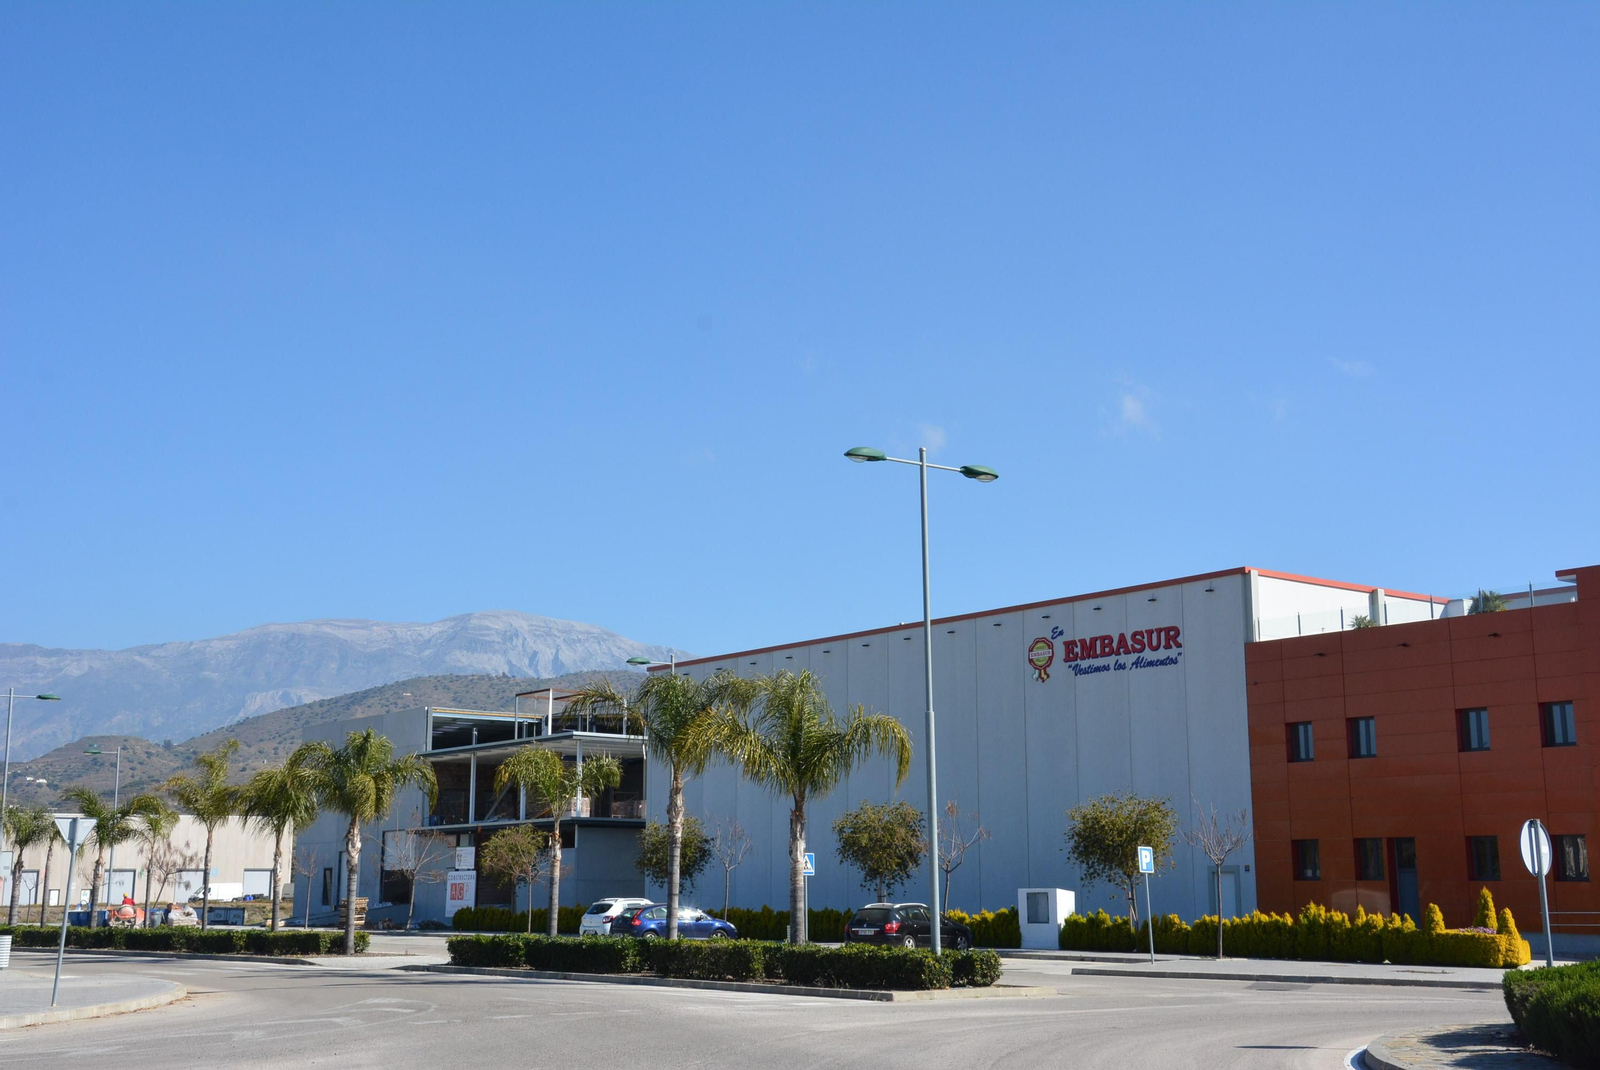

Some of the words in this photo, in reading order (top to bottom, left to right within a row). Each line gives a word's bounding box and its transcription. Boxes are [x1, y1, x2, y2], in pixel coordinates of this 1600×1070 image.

[1051, 626, 1064, 640] En
[1063, 626, 1182, 662] EMBASUR
[1114, 659, 1127, 671] los
[1141, 850, 1151, 870] P
